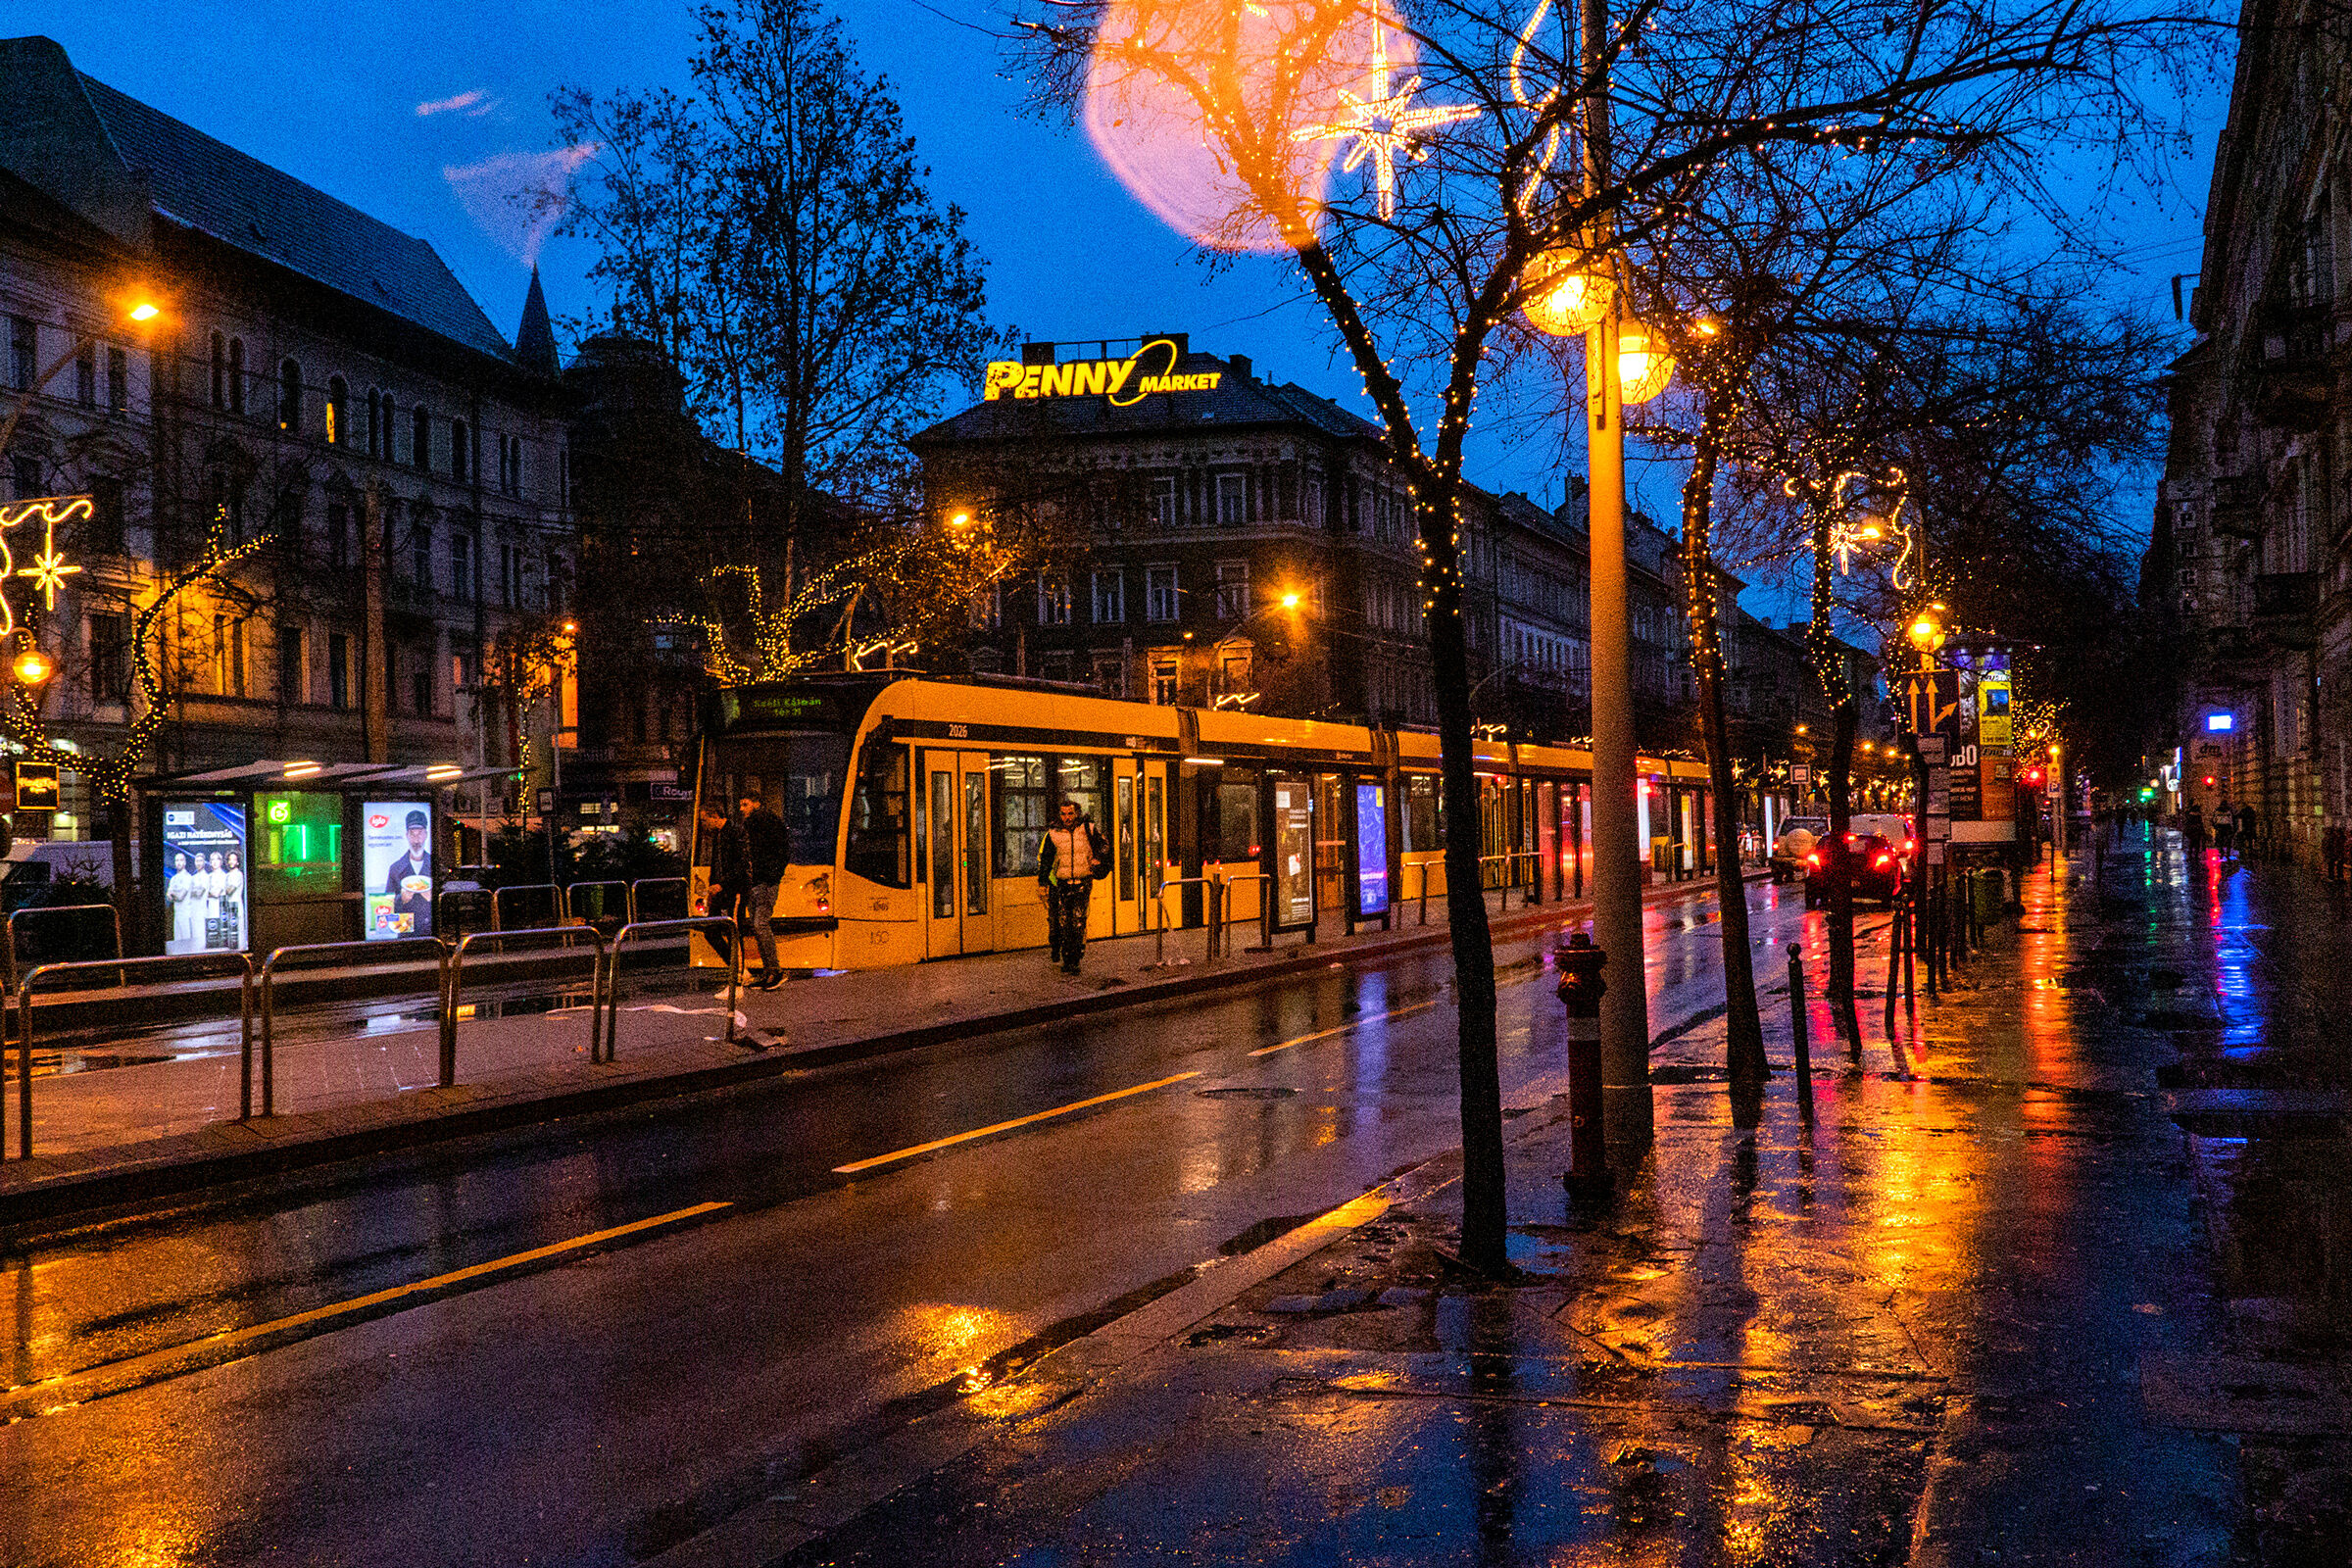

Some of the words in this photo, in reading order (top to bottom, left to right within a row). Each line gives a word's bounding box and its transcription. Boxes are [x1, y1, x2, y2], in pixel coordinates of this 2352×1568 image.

[984, 359, 1137, 401] PENNY
[1139, 372, 1221, 393] MARKET
[949, 723, 968, 738] 2026
